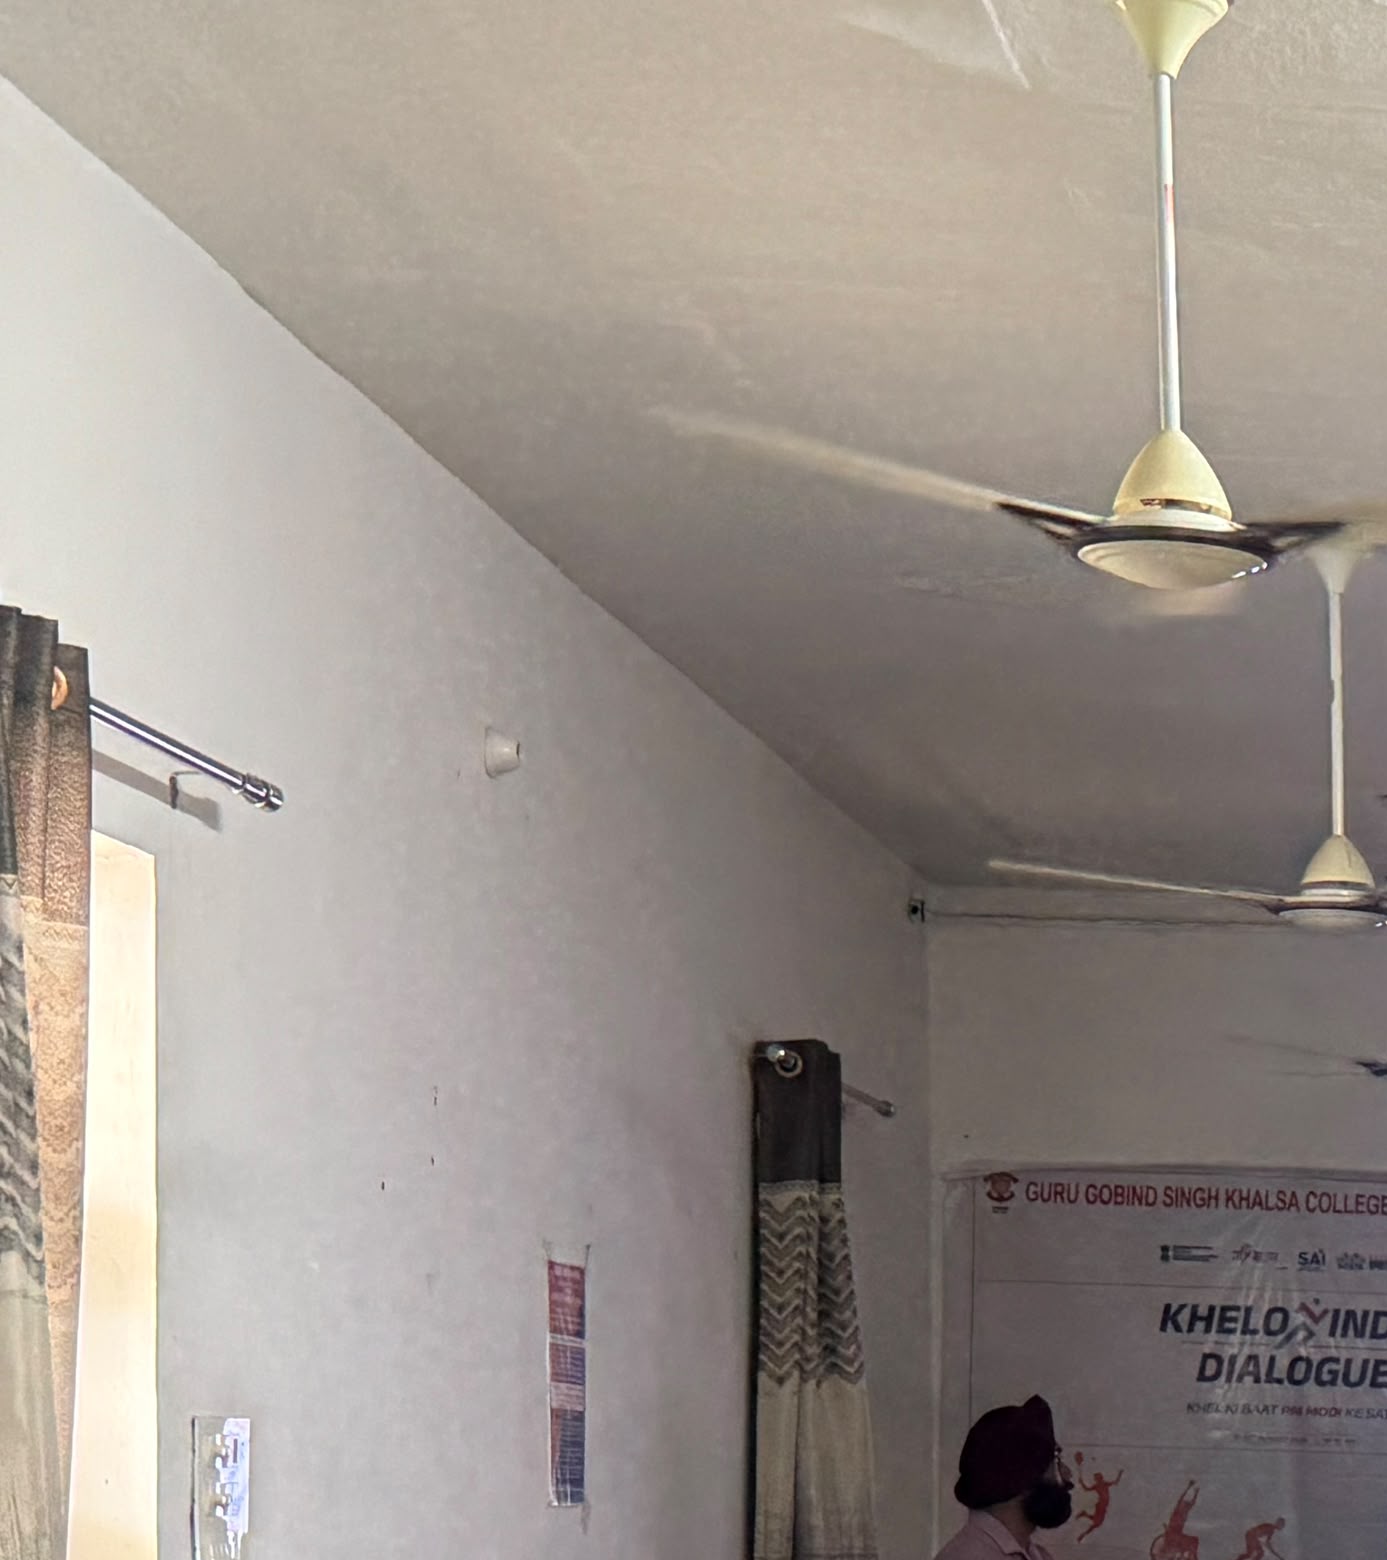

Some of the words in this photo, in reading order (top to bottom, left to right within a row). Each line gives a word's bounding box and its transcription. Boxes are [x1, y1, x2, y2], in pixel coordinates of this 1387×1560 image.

[1025, 1181, 1080, 1203] GURU
[1084, 1184, 1158, 1207] GOBIND
[1162, 1185, 1220, 1210] SINGH
[1225, 1188, 1301, 1213] KHALSA
[1158, 1302, 1290, 1337] KHELO
